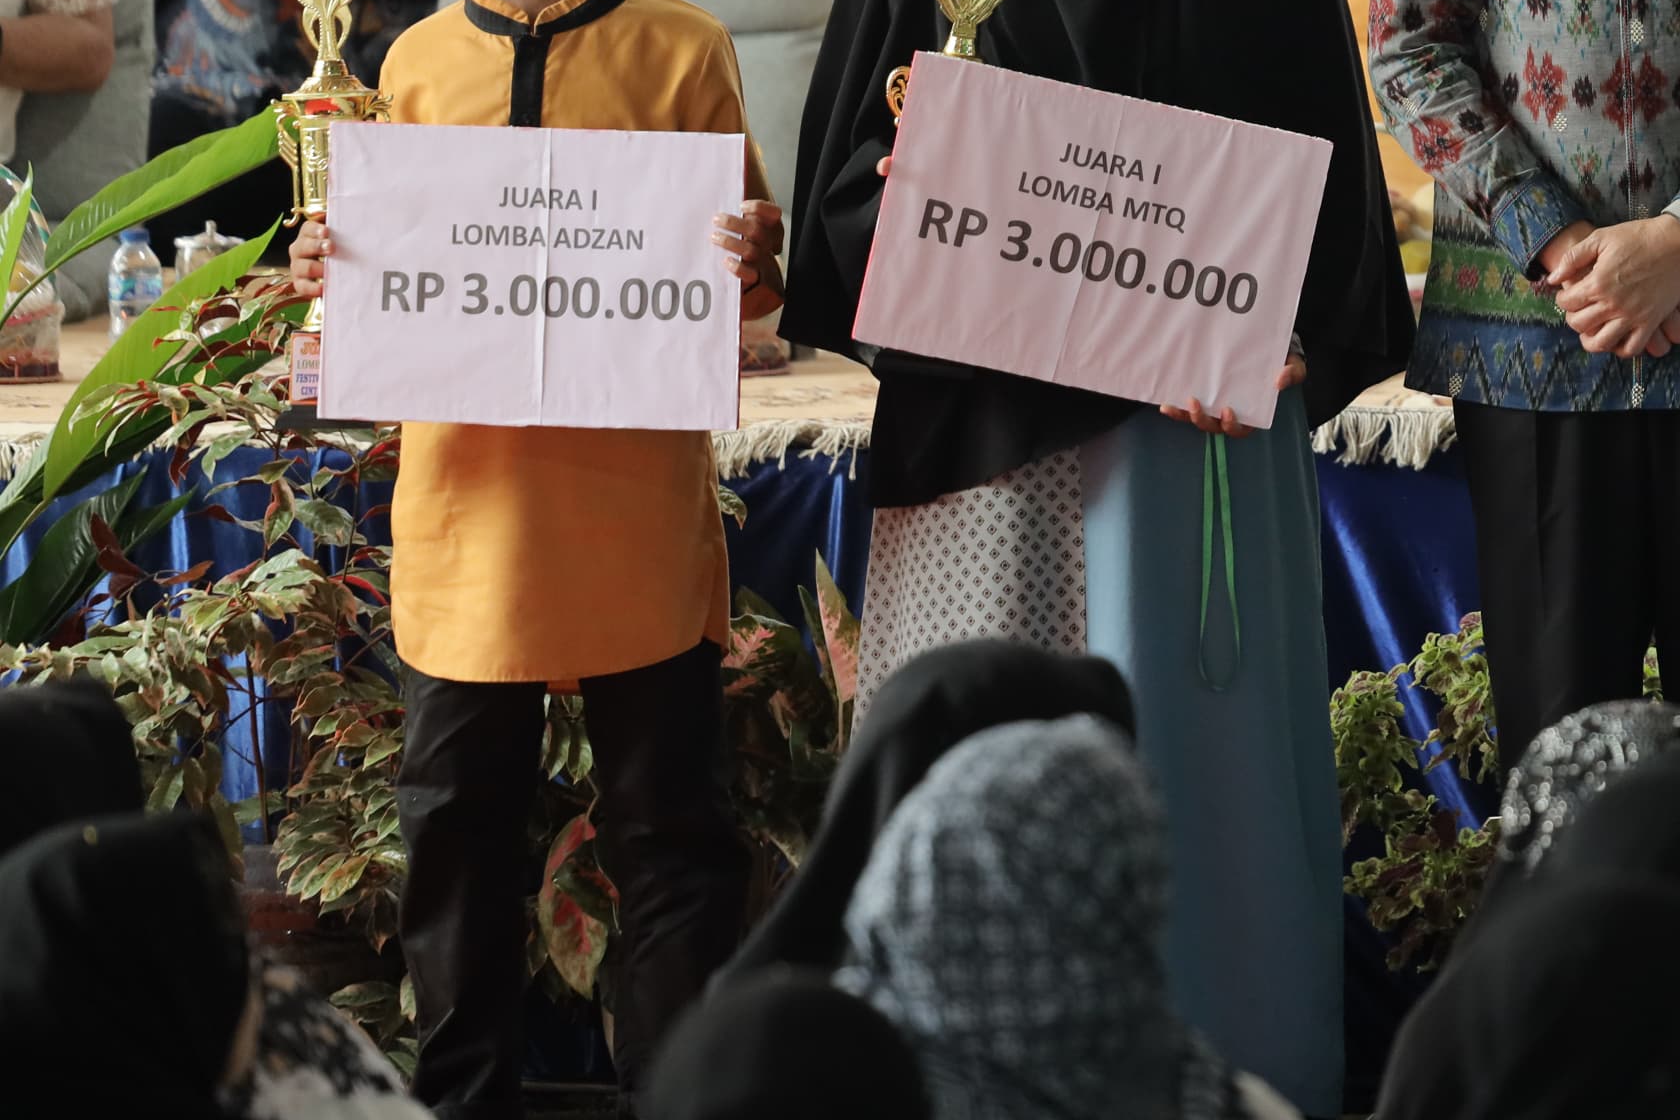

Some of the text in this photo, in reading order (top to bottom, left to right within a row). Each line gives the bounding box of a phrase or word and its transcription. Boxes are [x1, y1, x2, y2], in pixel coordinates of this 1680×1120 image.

[1058, 142, 1162, 185] JUARA I
[498, 186, 598, 212] JUARA I
[1017, 171, 1186, 235] LOMBA MTQ
[451, 223, 644, 251] LOMBA ADZAN
[917, 197, 1259, 315] RP 3.000.000
[381, 270, 712, 322] RP 3.000.000
